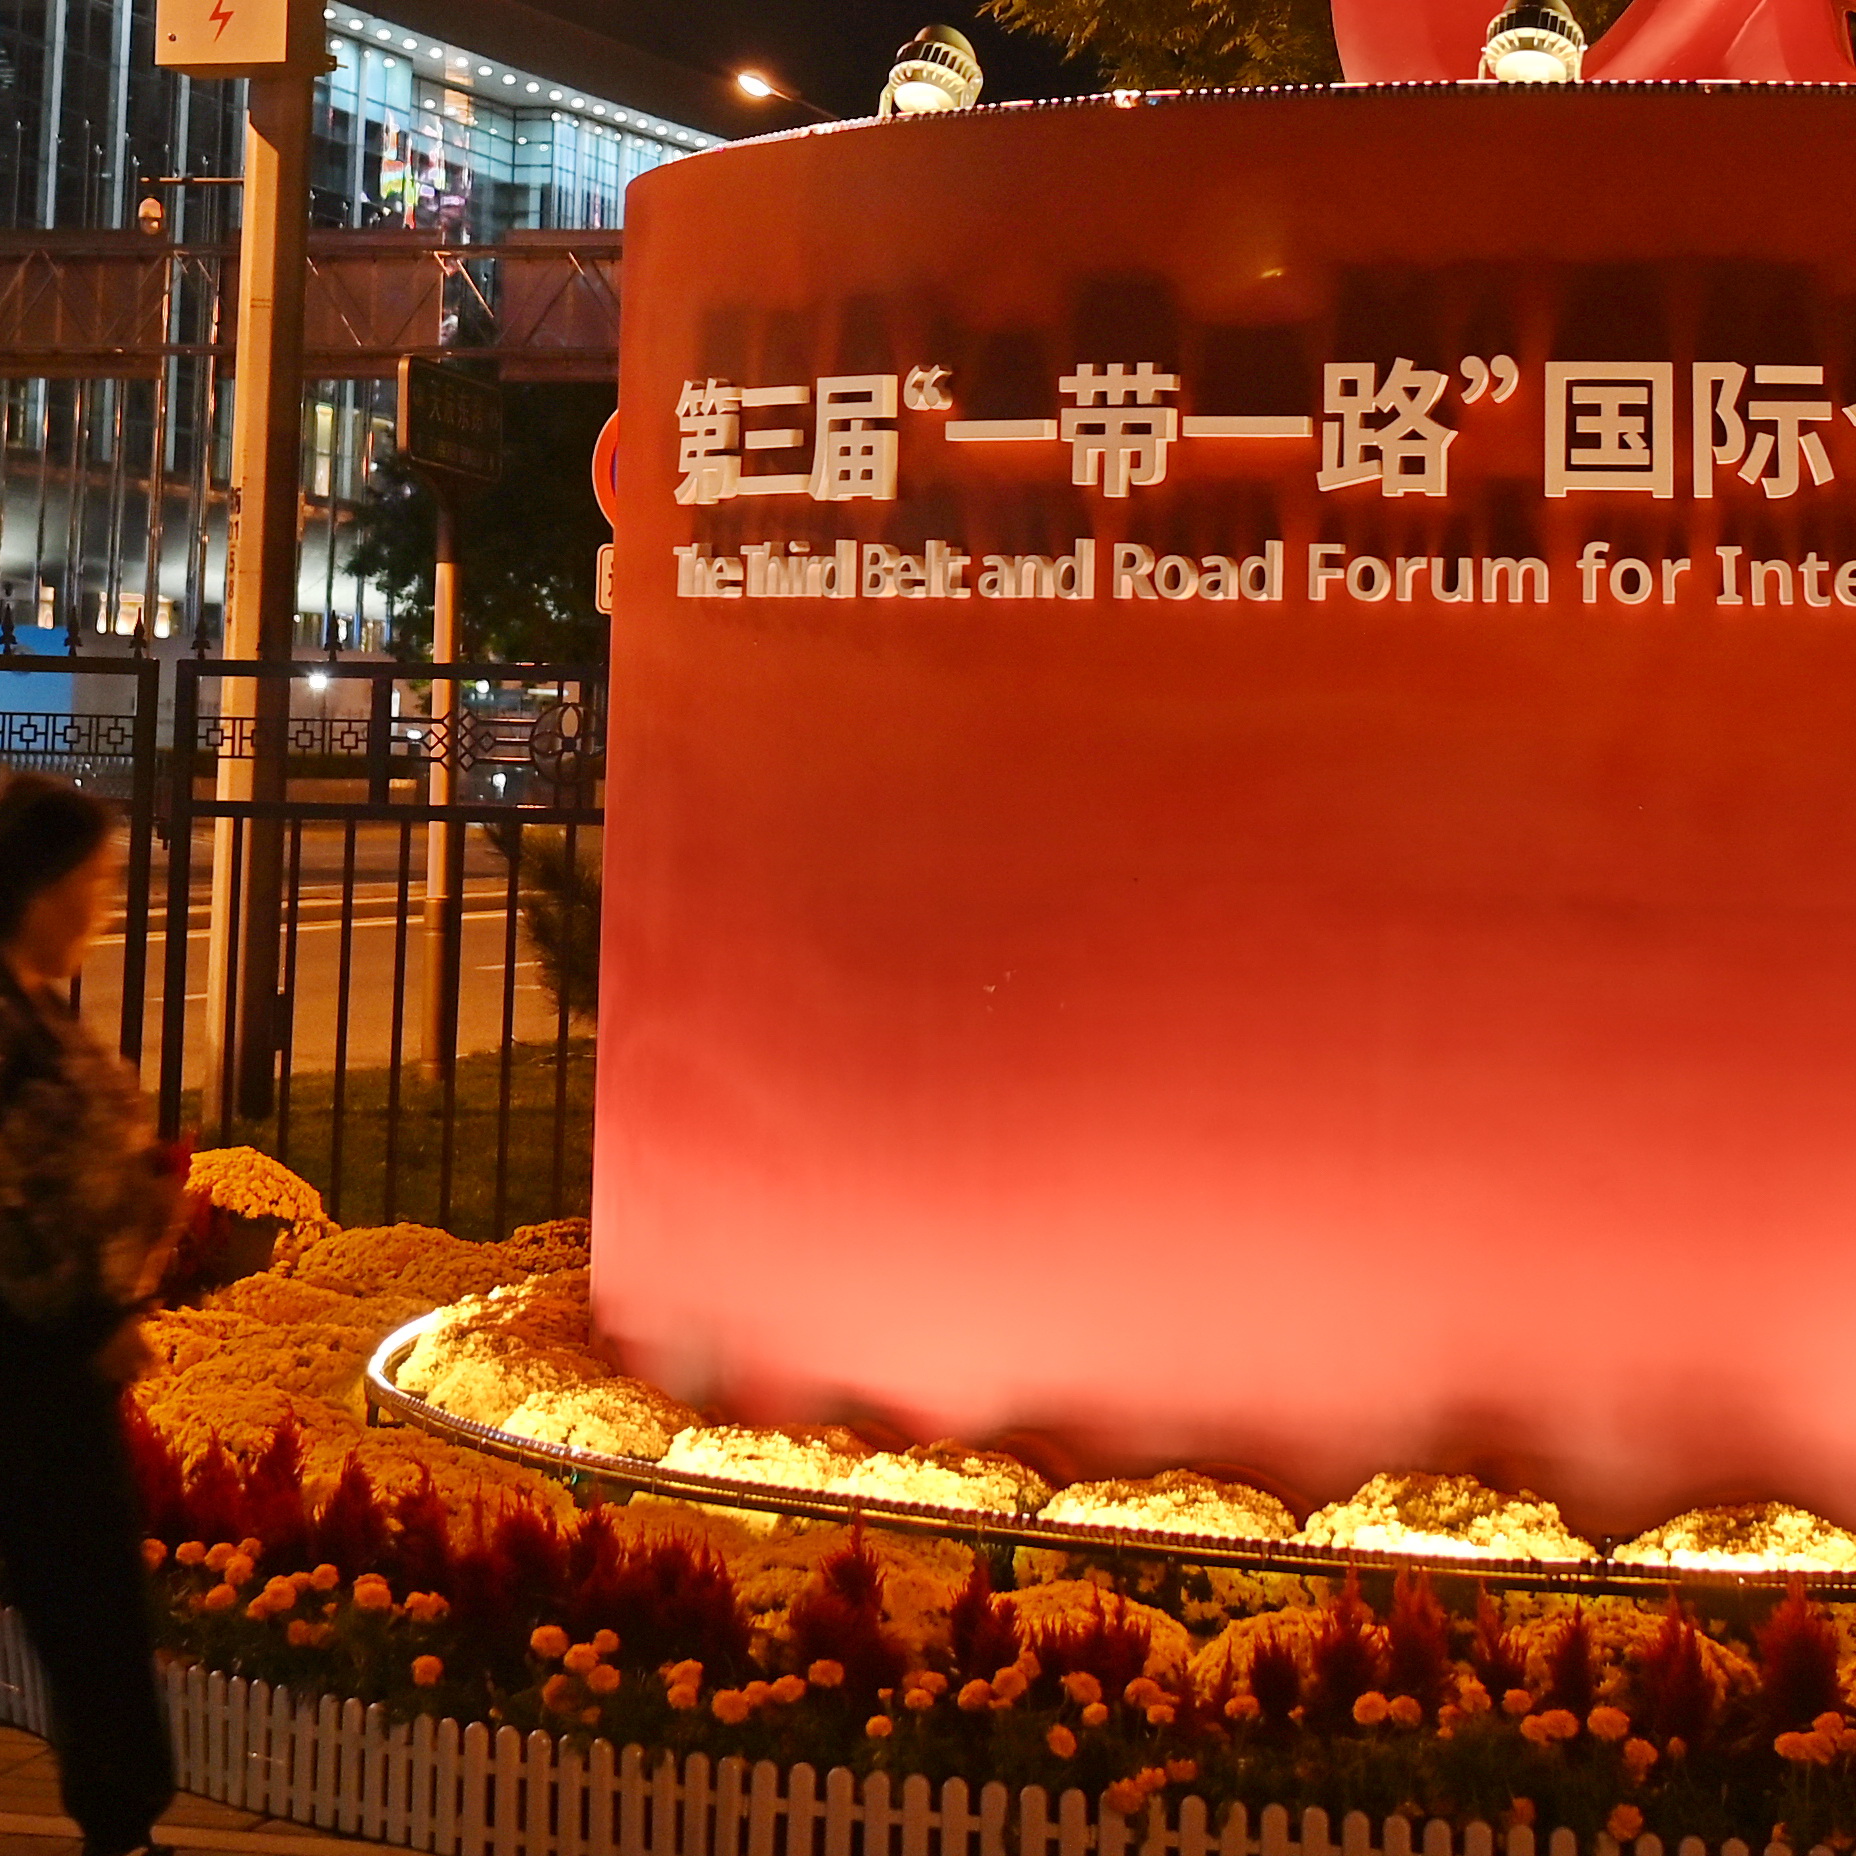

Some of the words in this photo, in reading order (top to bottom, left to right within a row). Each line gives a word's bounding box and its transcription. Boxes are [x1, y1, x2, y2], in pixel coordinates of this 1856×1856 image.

[673, 543, 743, 598] The
[740, 540, 857, 598] Third
[861, 540, 971, 599] Belt
[979, 538, 1094, 600] and
[1111, 540, 1282, 601] Road
[1308, 541, 1548, 604] Forum
[1577, 541, 1691, 605] for
